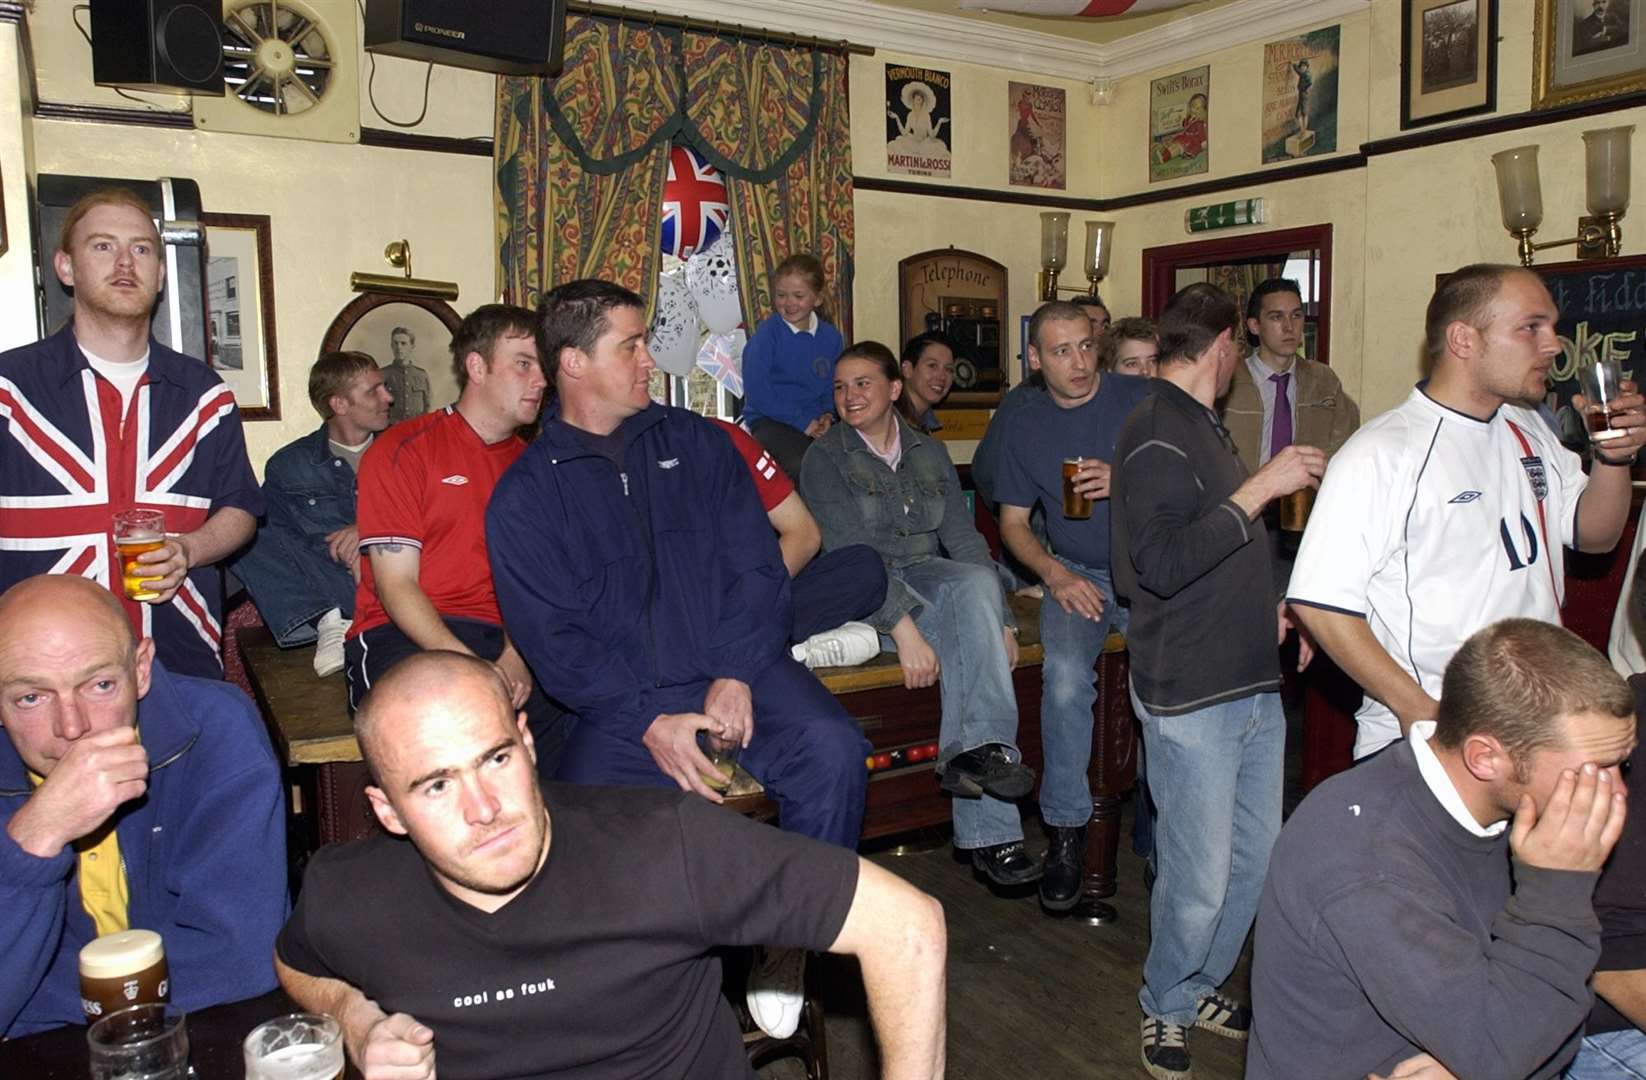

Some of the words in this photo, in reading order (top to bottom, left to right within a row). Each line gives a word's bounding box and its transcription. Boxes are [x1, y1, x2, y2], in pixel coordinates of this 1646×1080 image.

[424, 25, 465, 39] PIONEER
[925, 69, 949, 89] BIANCO
[921, 260, 990, 288] Telephone
[454, 991, 488, 1007] cool
[496, 988, 514, 1001] as
[521, 979, 555, 996] fcuk
